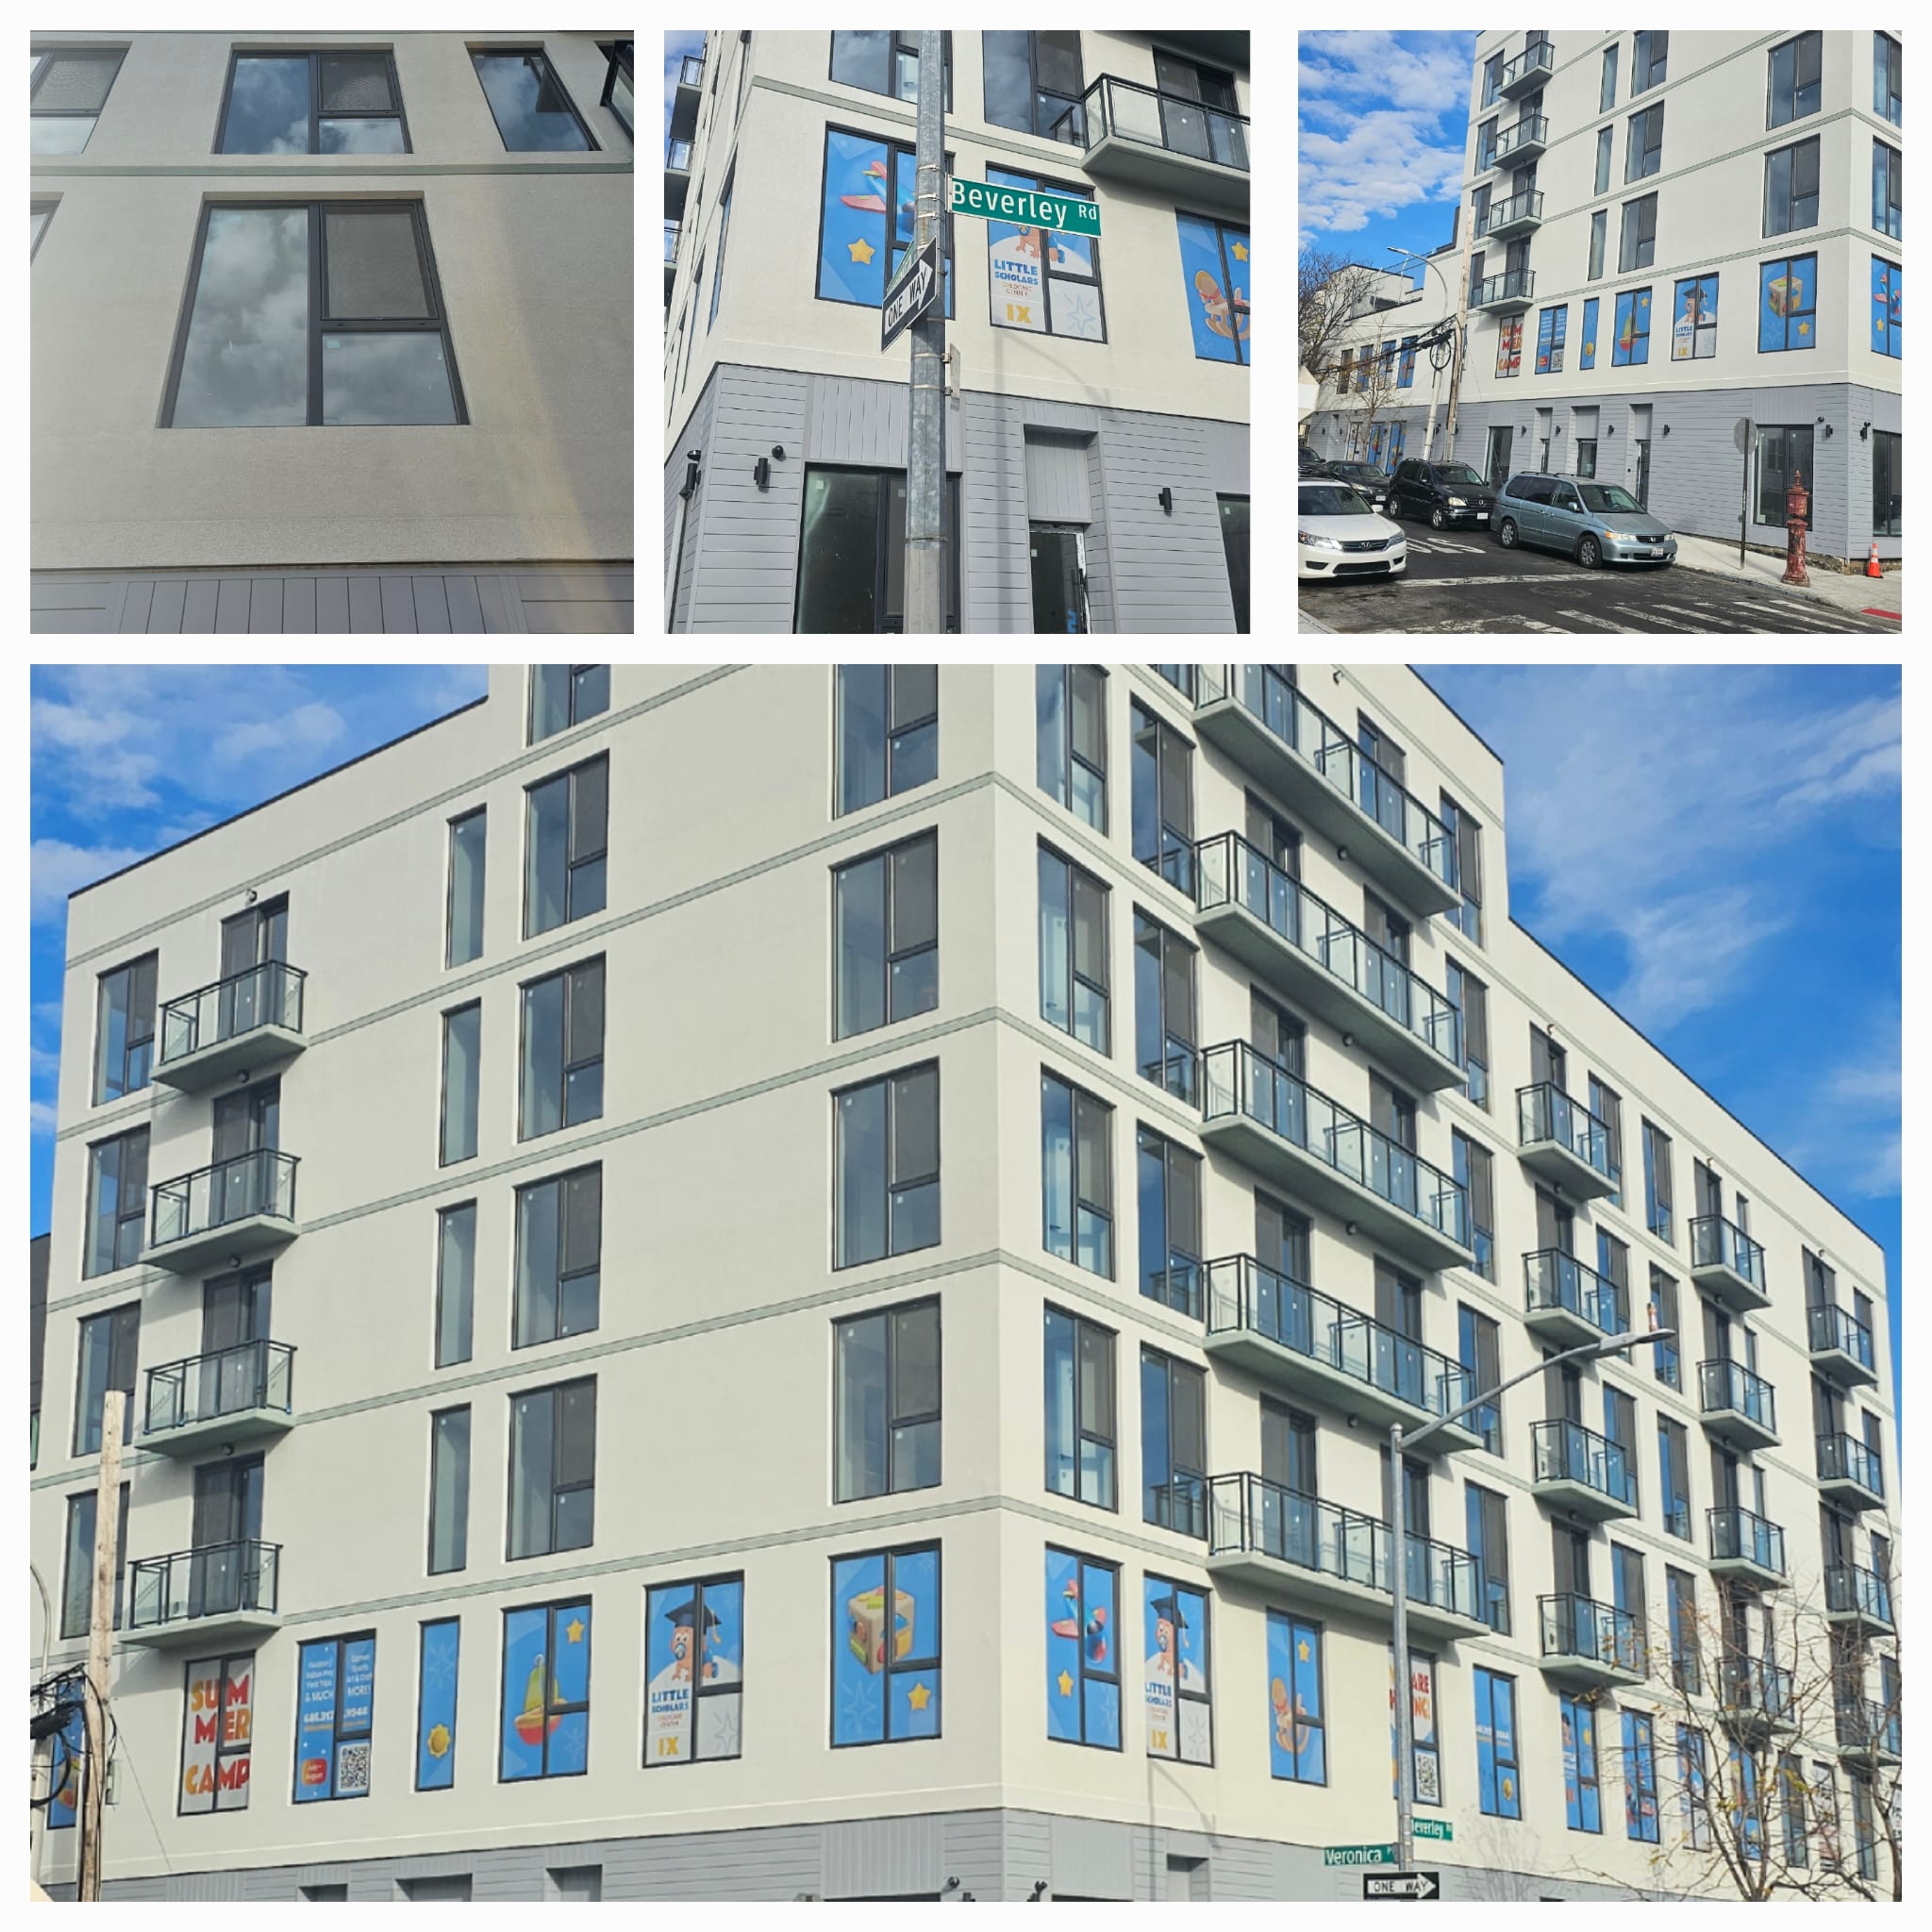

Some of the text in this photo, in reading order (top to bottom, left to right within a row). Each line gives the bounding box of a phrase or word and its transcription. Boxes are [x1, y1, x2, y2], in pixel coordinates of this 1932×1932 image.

[952, 180, 1097, 228] Beverley Rd
[994, 258, 1038, 275] LITTLE
[994, 271, 1039, 285] SCHOLARS
[888, 295, 904, 326] ONE
[909, 266, 927, 305] WAY
[1006, 303, 1031, 325] IX
[191, 1675, 249, 1711] SUM
[652, 1689, 689, 1703] LITTLE
[194, 1708, 250, 1744] MER
[658, 1736, 679, 1757] IX
[1151, 1729, 1168, 1750] IX
[185, 1758, 250, 1794] CAMP
[1325, 1845, 1381, 1865] Veronica
[1374, 1880, 1428, 1893] ONE WAY
